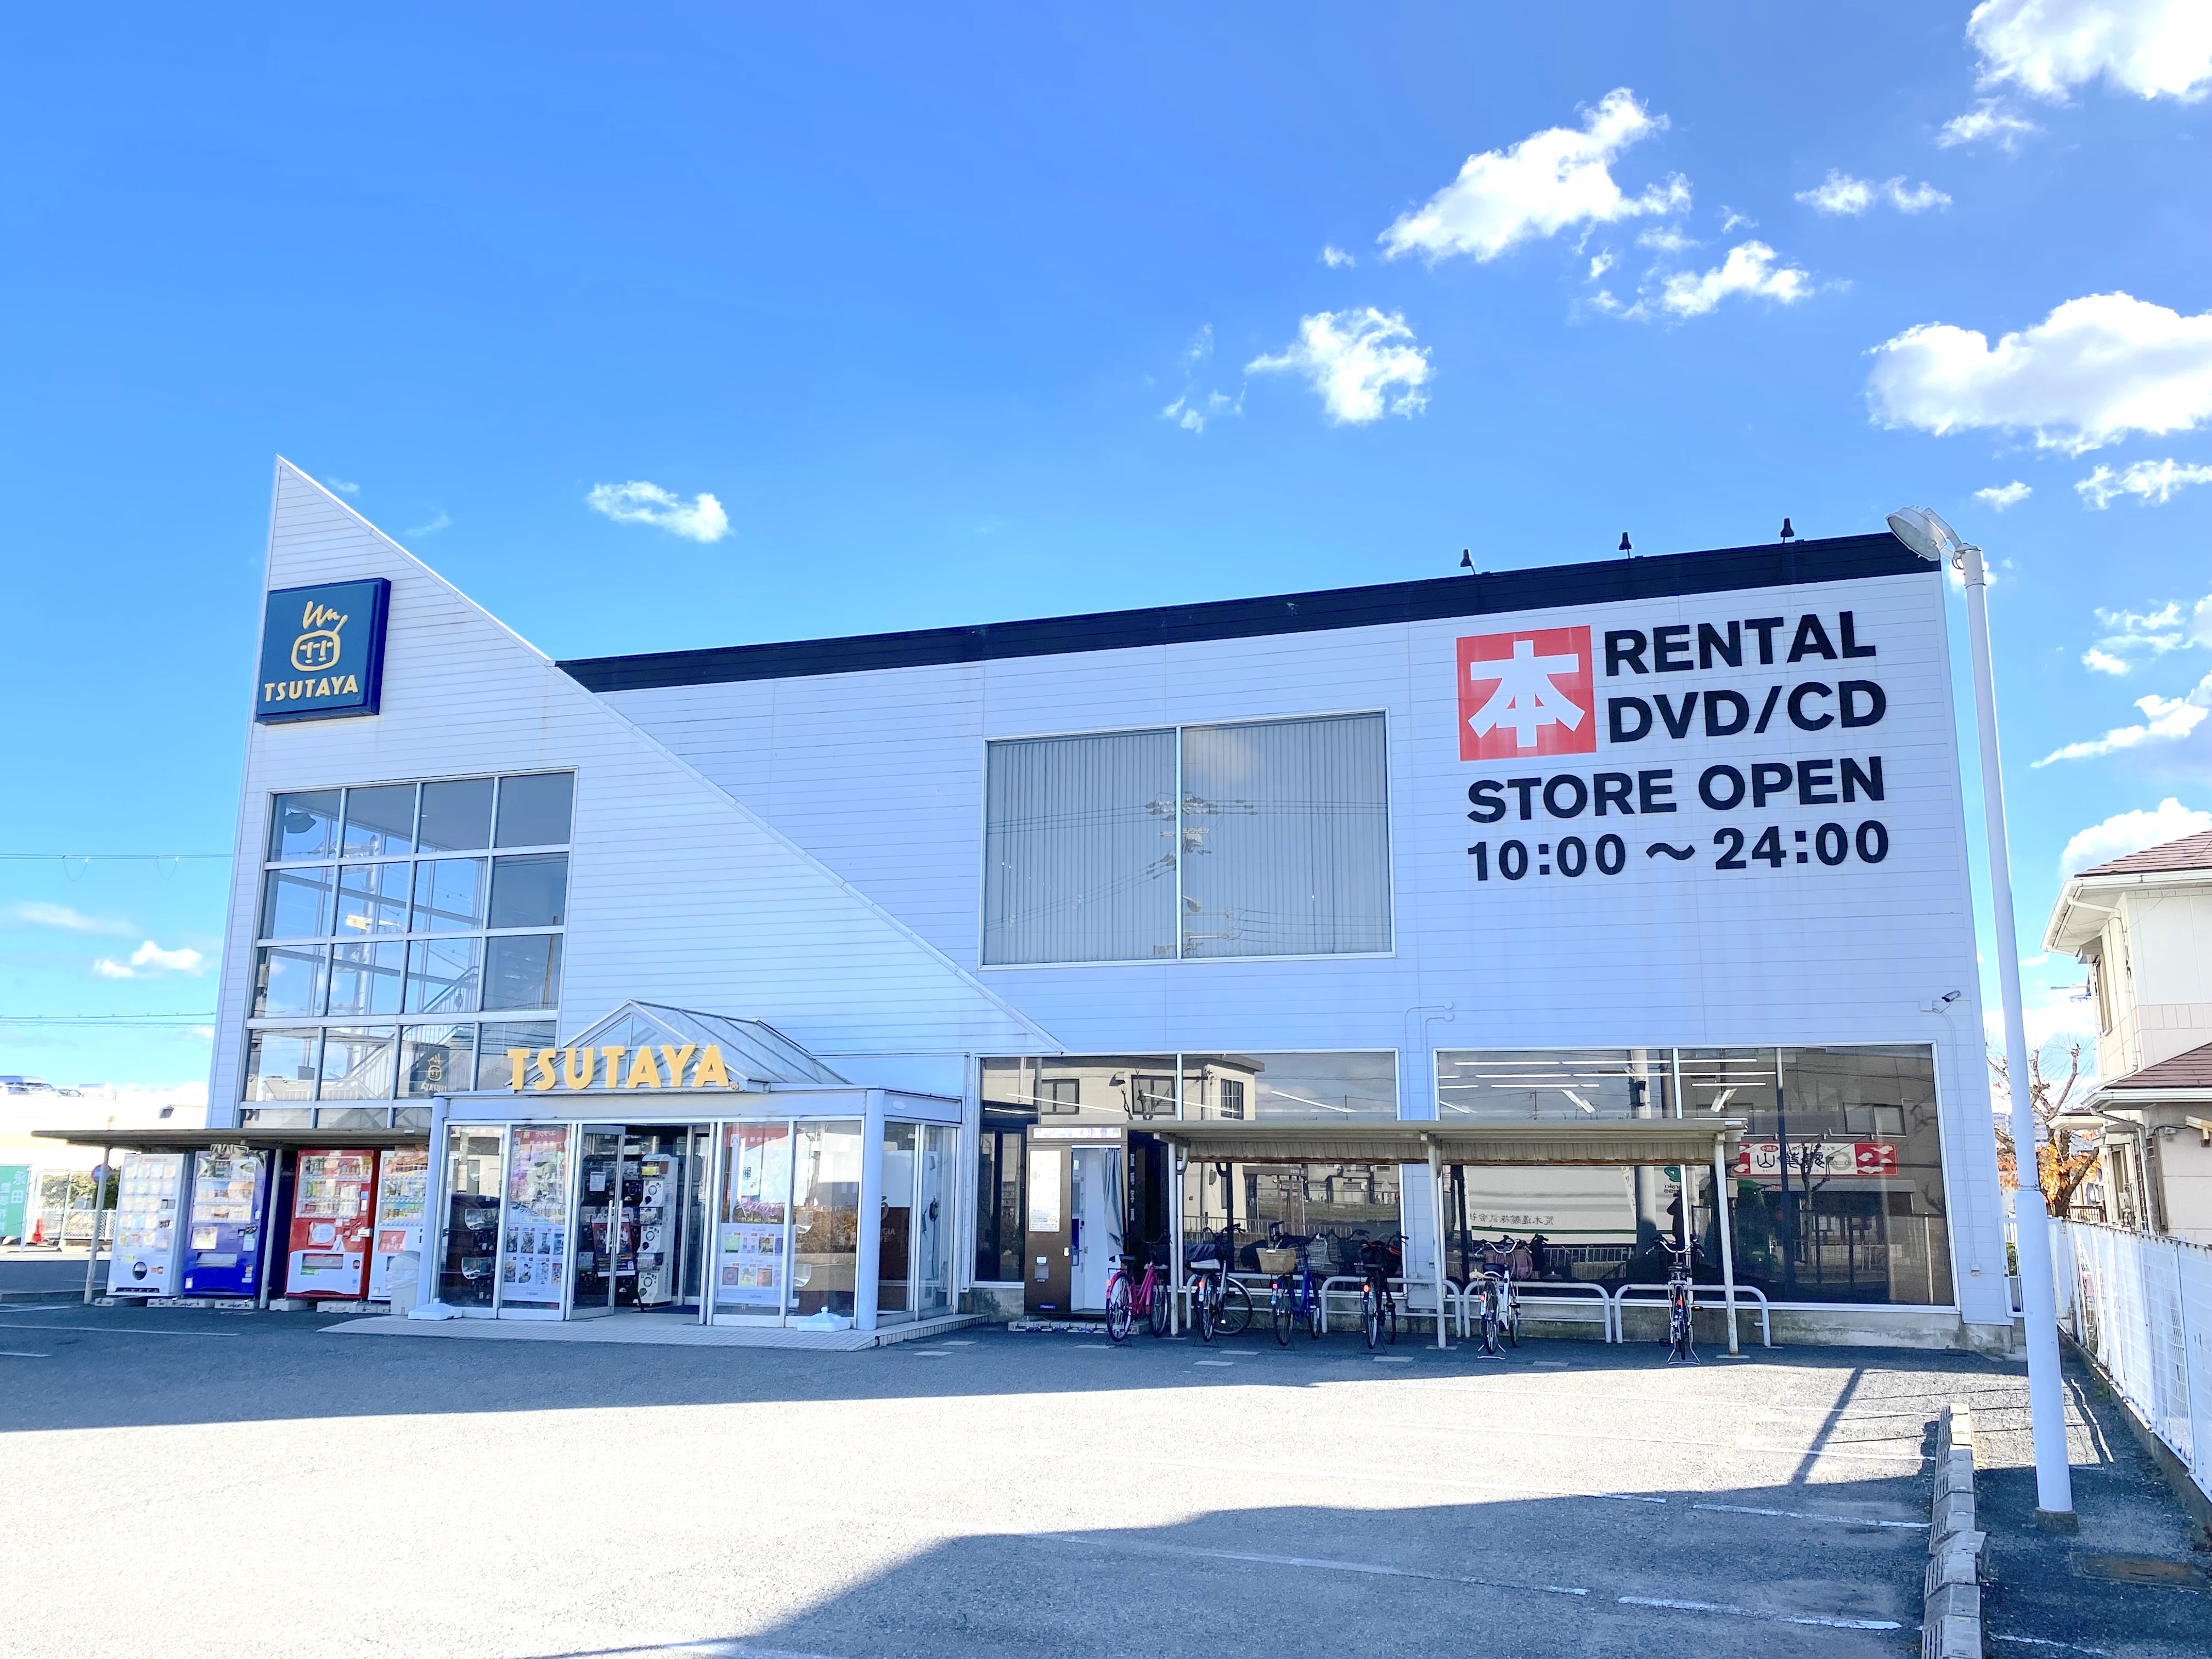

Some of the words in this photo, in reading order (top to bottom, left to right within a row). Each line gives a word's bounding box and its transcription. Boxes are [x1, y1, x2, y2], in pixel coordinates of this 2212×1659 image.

[1605, 611, 1877, 676] RENTAL
[264, 675, 358, 702] TSUTAYA
[1468, 640, 1585, 747] 本
[1607, 679, 1886, 743] DVD/CD
[1467, 769, 1677, 823] STORE
[1699, 755, 1884, 810] OPEN
[1468, 833, 1626, 881] 10:00
[1713, 820, 1888, 870] 24:00
[507, 1044, 730, 1091] TSUTAYA
[10, 1171, 26, 1204] 永田
